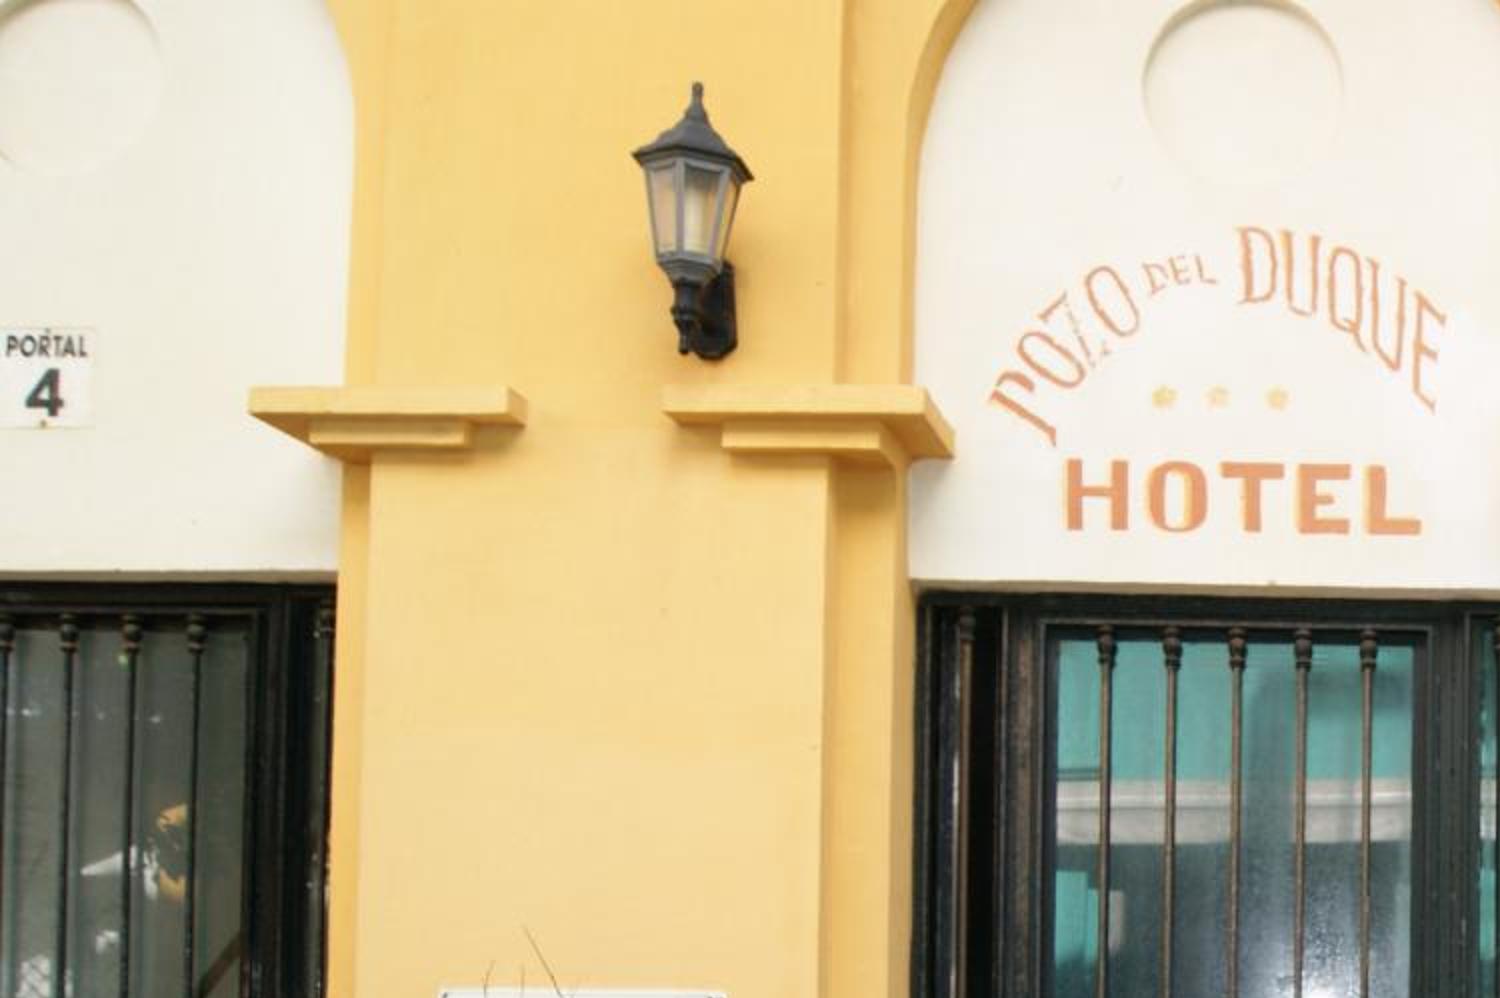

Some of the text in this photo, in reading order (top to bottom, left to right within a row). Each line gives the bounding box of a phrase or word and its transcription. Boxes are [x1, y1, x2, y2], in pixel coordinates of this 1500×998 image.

[6, 335, 87, 357] PORTAL
[989, 226, 1447, 447] POZO DEL DUQUE
[25, 368, 64, 416] 4
[1065, 458, 1422, 535] HOTEL
